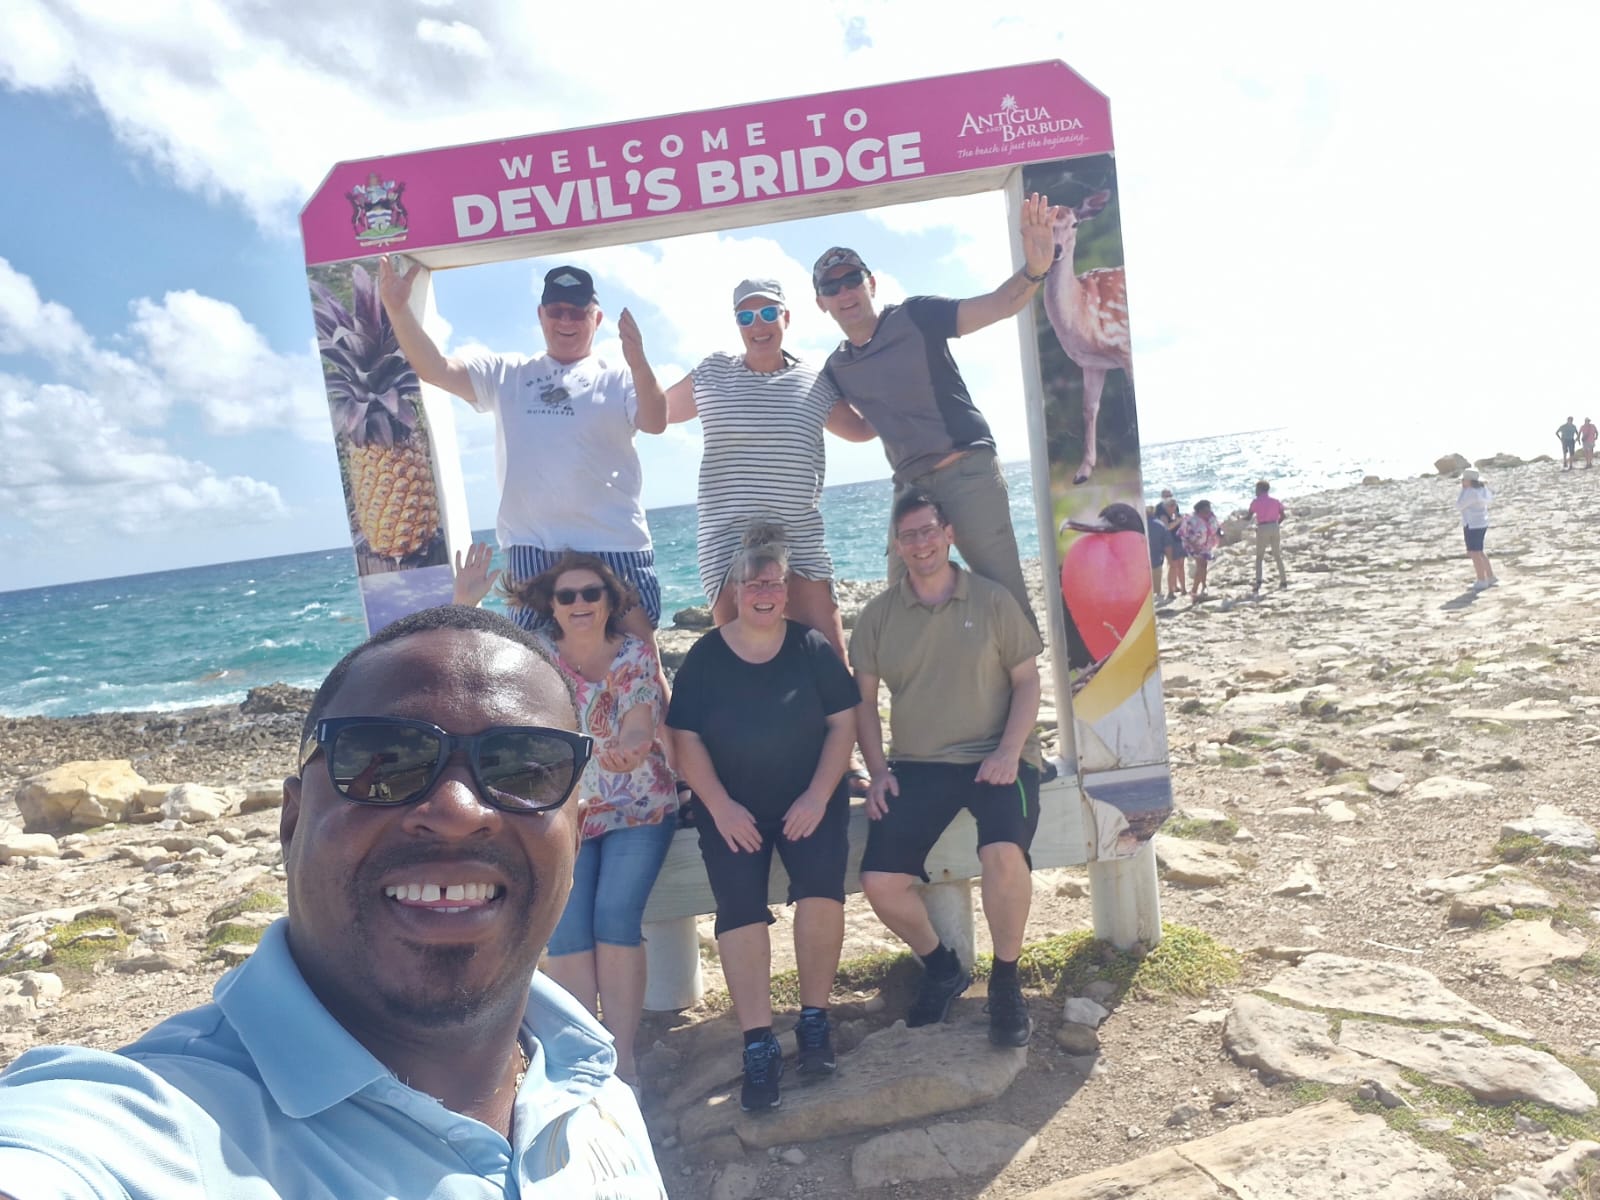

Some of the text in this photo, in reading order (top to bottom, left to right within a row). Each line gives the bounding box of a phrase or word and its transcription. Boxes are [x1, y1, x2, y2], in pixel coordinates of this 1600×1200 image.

[957, 105, 1051, 137] ANTIGUA
[1002, 117, 1084, 142] BARBUDA
[499, 108, 869, 180] WELCOME TO
[957, 147, 974, 159] The
[975, 143, 1000, 156] beach
[1000, 142, 1008, 152] is
[1008, 140, 1025, 155] just
[1027, 137, 1041, 149] the
[452, 131, 925, 239] DEVIL'S BRIDGE
